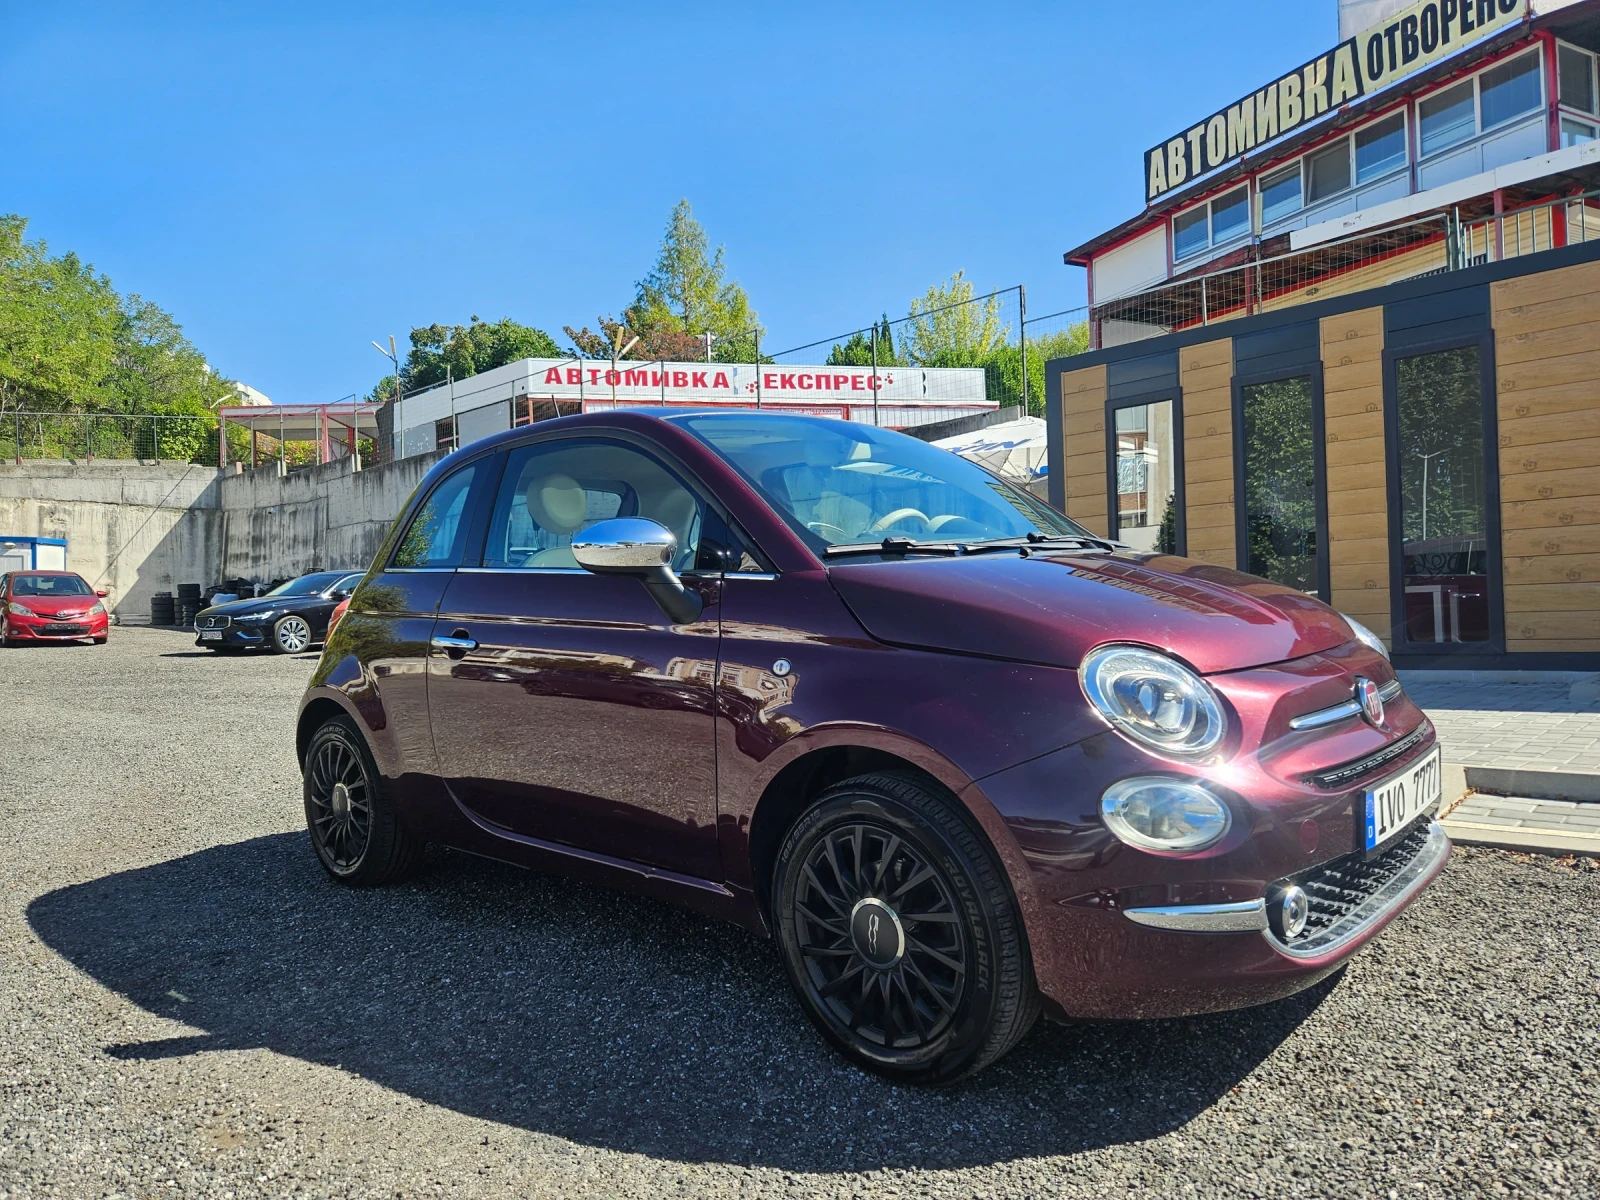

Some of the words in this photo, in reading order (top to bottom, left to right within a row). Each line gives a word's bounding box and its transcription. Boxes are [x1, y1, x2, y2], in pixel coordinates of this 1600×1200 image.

[1149, 43, 1358, 199] АВТОМИВКА
[544, 367, 730, 389] АВТОМИВКА
[764, 373, 883, 391] ЕКСПРЕС
[1378, 781, 1406, 836] IVO
[1413, 755, 1437, 811] 7777
